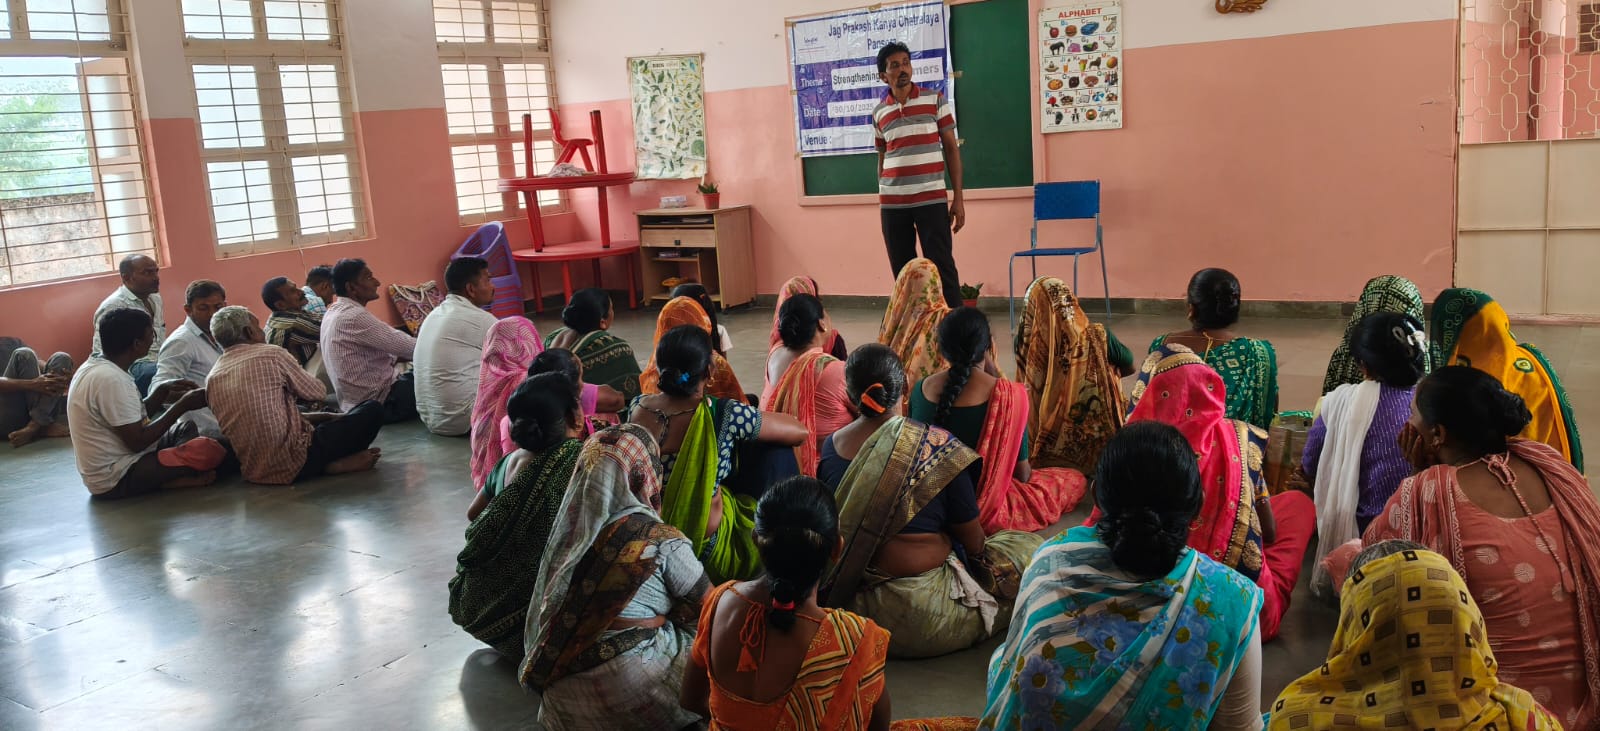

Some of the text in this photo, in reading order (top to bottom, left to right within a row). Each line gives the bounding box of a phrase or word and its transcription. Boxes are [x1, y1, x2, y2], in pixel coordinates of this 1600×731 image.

[1058, 8, 1102, 18] ALPHABET
[828, 24, 842, 38] Jag
[842, 20, 872, 34] Prakash
[874, 18, 896, 32] Kanya
[832, 70, 880, 85] Strengthening
[804, 108, 821, 118] Date
[805, 135, 827, 146] Venue
